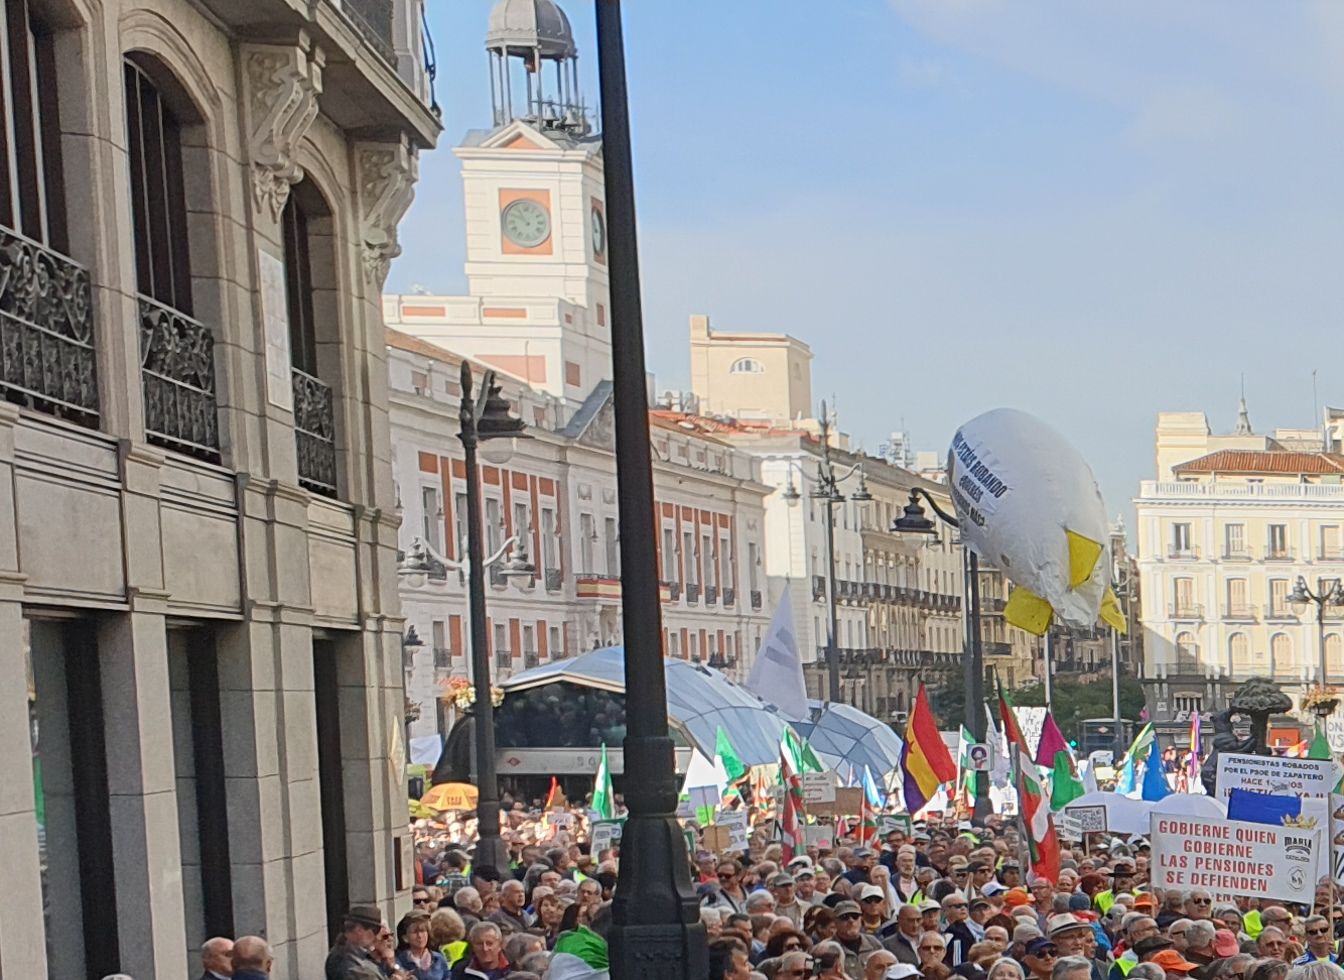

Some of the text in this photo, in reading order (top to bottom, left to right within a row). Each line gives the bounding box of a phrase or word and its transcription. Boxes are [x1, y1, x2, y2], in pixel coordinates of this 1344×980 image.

[970, 461, 1008, 498] ROBANDO
[1224, 766, 1239, 774] POR
[1250, 769, 1269, 777] PSOE
[1282, 771, 1324, 781] ZAPATERO
[1228, 757, 1320, 771] PENSIONISTAS ROBADOS
[1241, 777, 1263, 786] HACE
[1159, 820, 1277, 845] GOBIERNE QUIEN
[1184, 840, 1253, 859] GOBIERNE
[1160, 854, 1274, 877] LAS PENSIONES
[1166, 871, 1268, 892] SE DEFIENDEN
